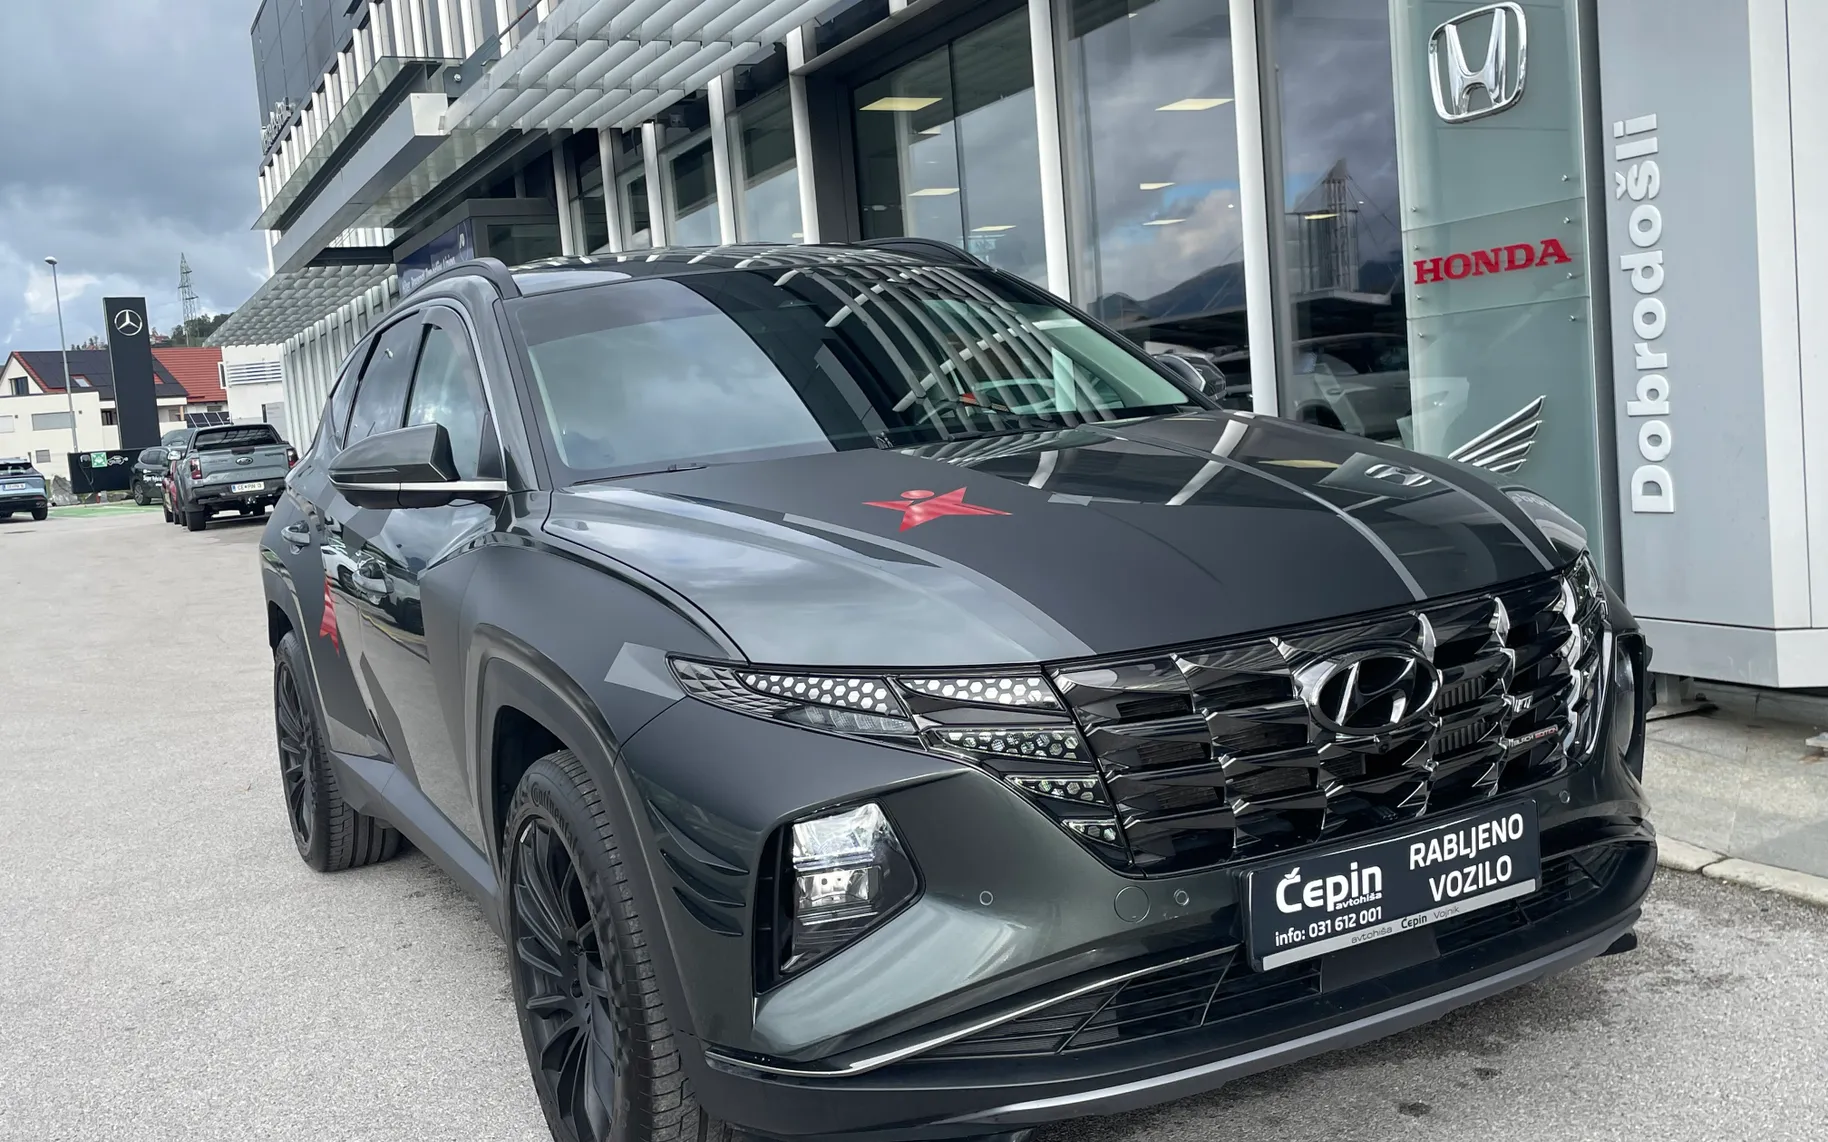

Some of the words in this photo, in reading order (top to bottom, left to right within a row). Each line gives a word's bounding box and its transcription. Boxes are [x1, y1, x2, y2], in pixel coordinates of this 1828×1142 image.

[1413, 238, 1572, 285] HONDA
[1613, 113, 1675, 513] Dobrodošli
[1535, 727, 1557, 739] EDITION
[1409, 813, 1524, 870] RABLJENO
[1276, 861, 1382, 914] Čepin
[1335, 891, 1383, 910] avtohiša
[1429, 855, 1513, 902] VOZILO
[1275, 927, 1306, 947] info:
[1308, 919, 1332, 938] 031
[1334, 913, 1357, 931] 612
[1359, 906, 1382, 925] 001
[1351, 926, 1393, 944] avtohiša
[1432, 905, 1460, 920] Vojnik
